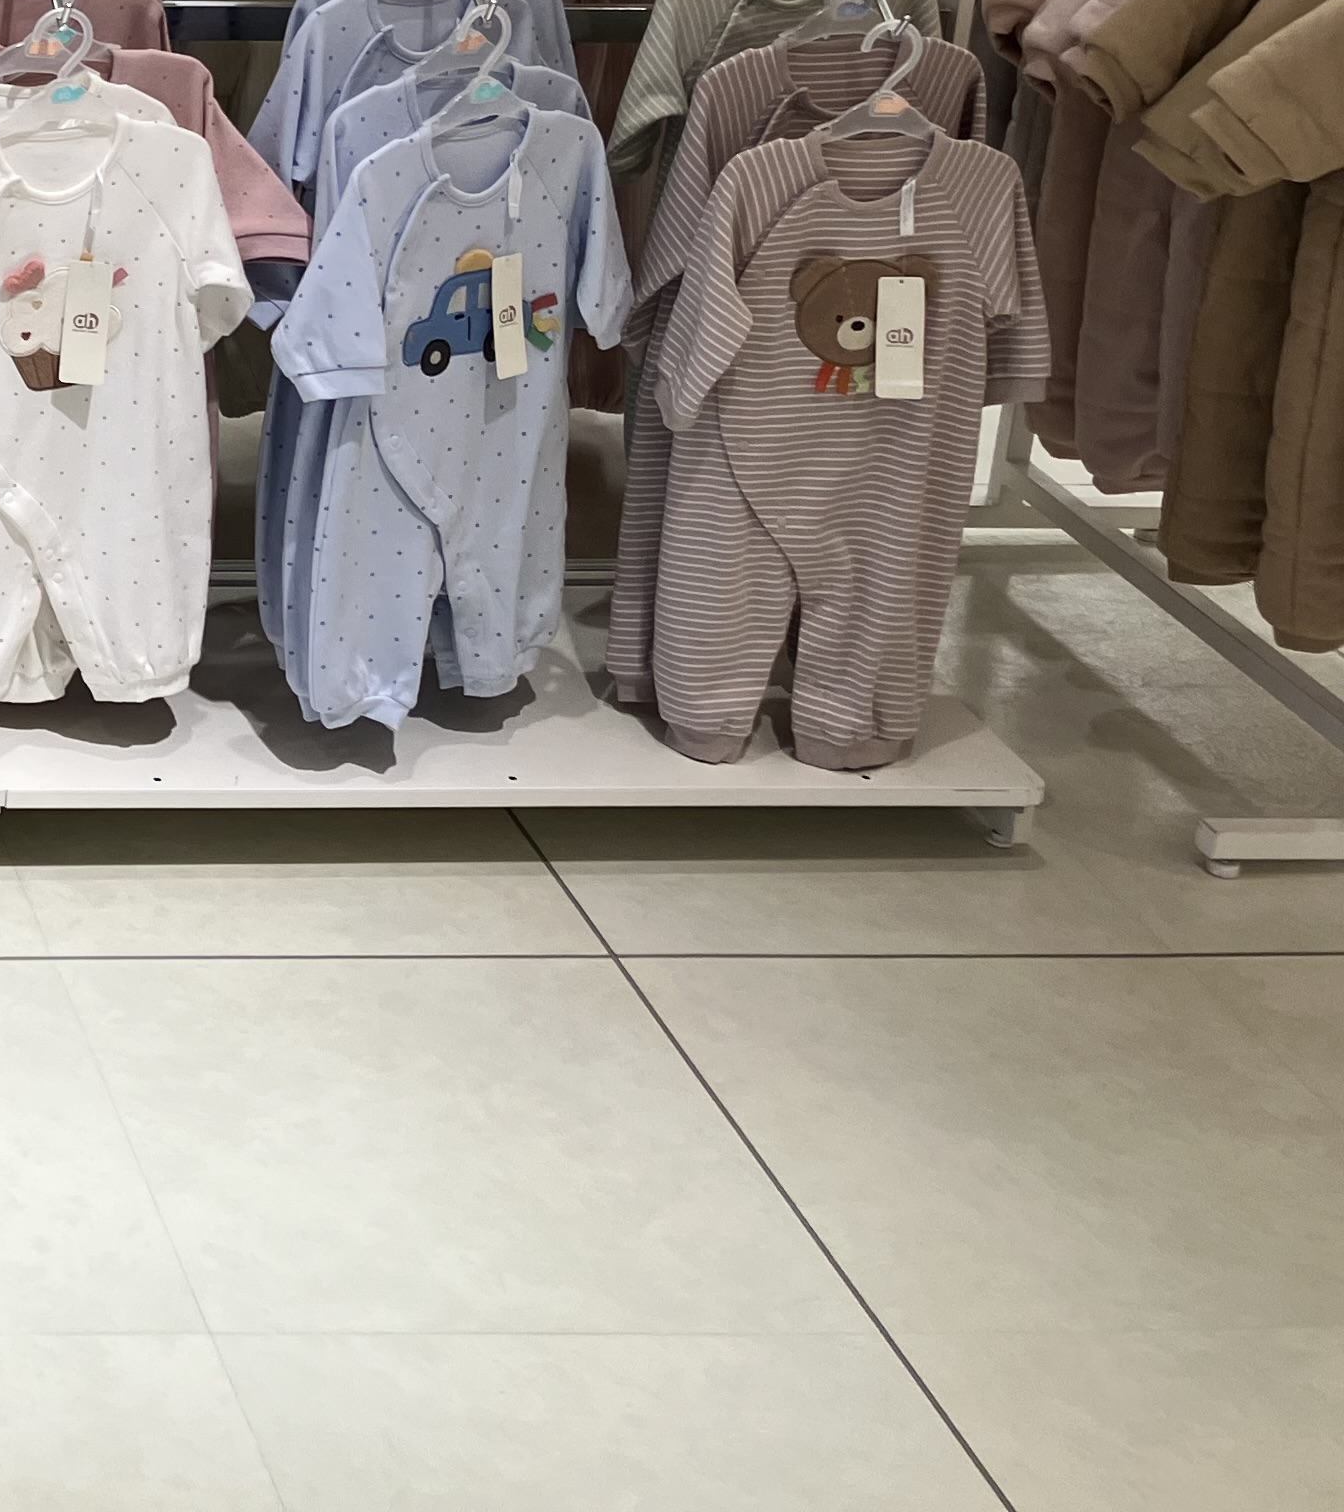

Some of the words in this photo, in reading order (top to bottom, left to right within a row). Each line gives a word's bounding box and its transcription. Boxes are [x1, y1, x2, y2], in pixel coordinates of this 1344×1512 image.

[73, 313, 99, 330] ah
[499, 306, 517, 324] ah
[886, 328, 914, 344] ah
